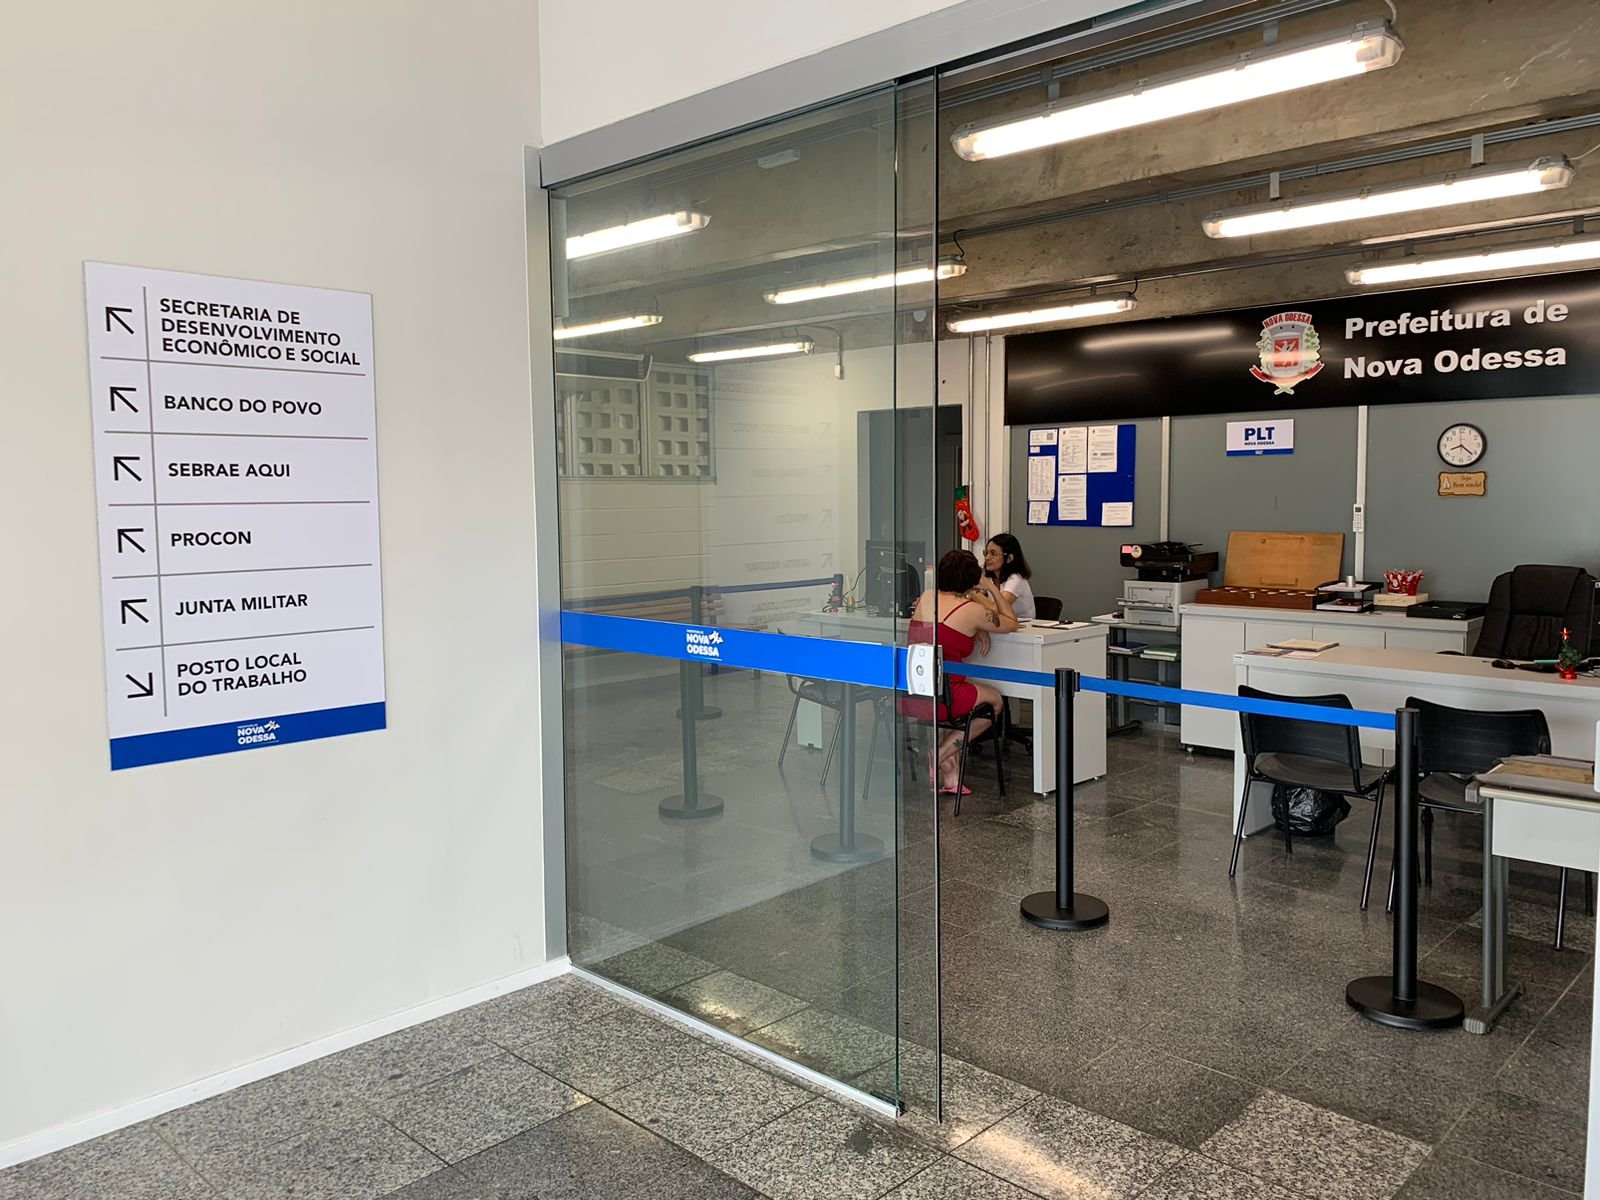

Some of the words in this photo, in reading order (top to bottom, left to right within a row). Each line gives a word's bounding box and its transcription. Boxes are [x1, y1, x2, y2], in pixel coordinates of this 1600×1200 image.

[160, 298, 272, 323] SECRETARIA
[277, 310, 300, 325] DE
[1263, 314, 1284, 329] NOVA
[1285, 312, 1311, 324] ODESSA
[1345, 308, 1511, 340] Prefeitura
[1523, 299, 1569, 324] de
[161, 318, 340, 346] DESENVOLVIMENTO
[162, 338, 282, 360] ECONÔMICO
[285, 348, 295, 361] E
[301, 349, 360, 366] SOCIAL
[1344, 356, 1423, 379] Nova
[1433, 347, 1567, 373] Odessa
[164, 395, 233, 412] BANCO
[239, 398, 267, 413] DO
[272, 400, 322, 415] POVO
[1244, 426, 1275, 441] PLT
[168, 462, 239, 477] SEBRAE
[246, 463, 290, 478] AQUI
[171, 531, 252, 547] PROCON
[175, 599, 236, 616] JUNTA
[242, 594, 308, 611] MILITAR
[686, 632, 710, 645] NOVA
[686, 643, 719, 657] ODESSA
[177, 659, 239, 677] POSTO
[246, 652, 302, 670] LOCAL
[178, 681, 207, 696] DO
[212, 669, 307, 691] TRABALHO
[237, 726, 265, 737] NOVA
[238, 732, 276, 745] ODESSA
